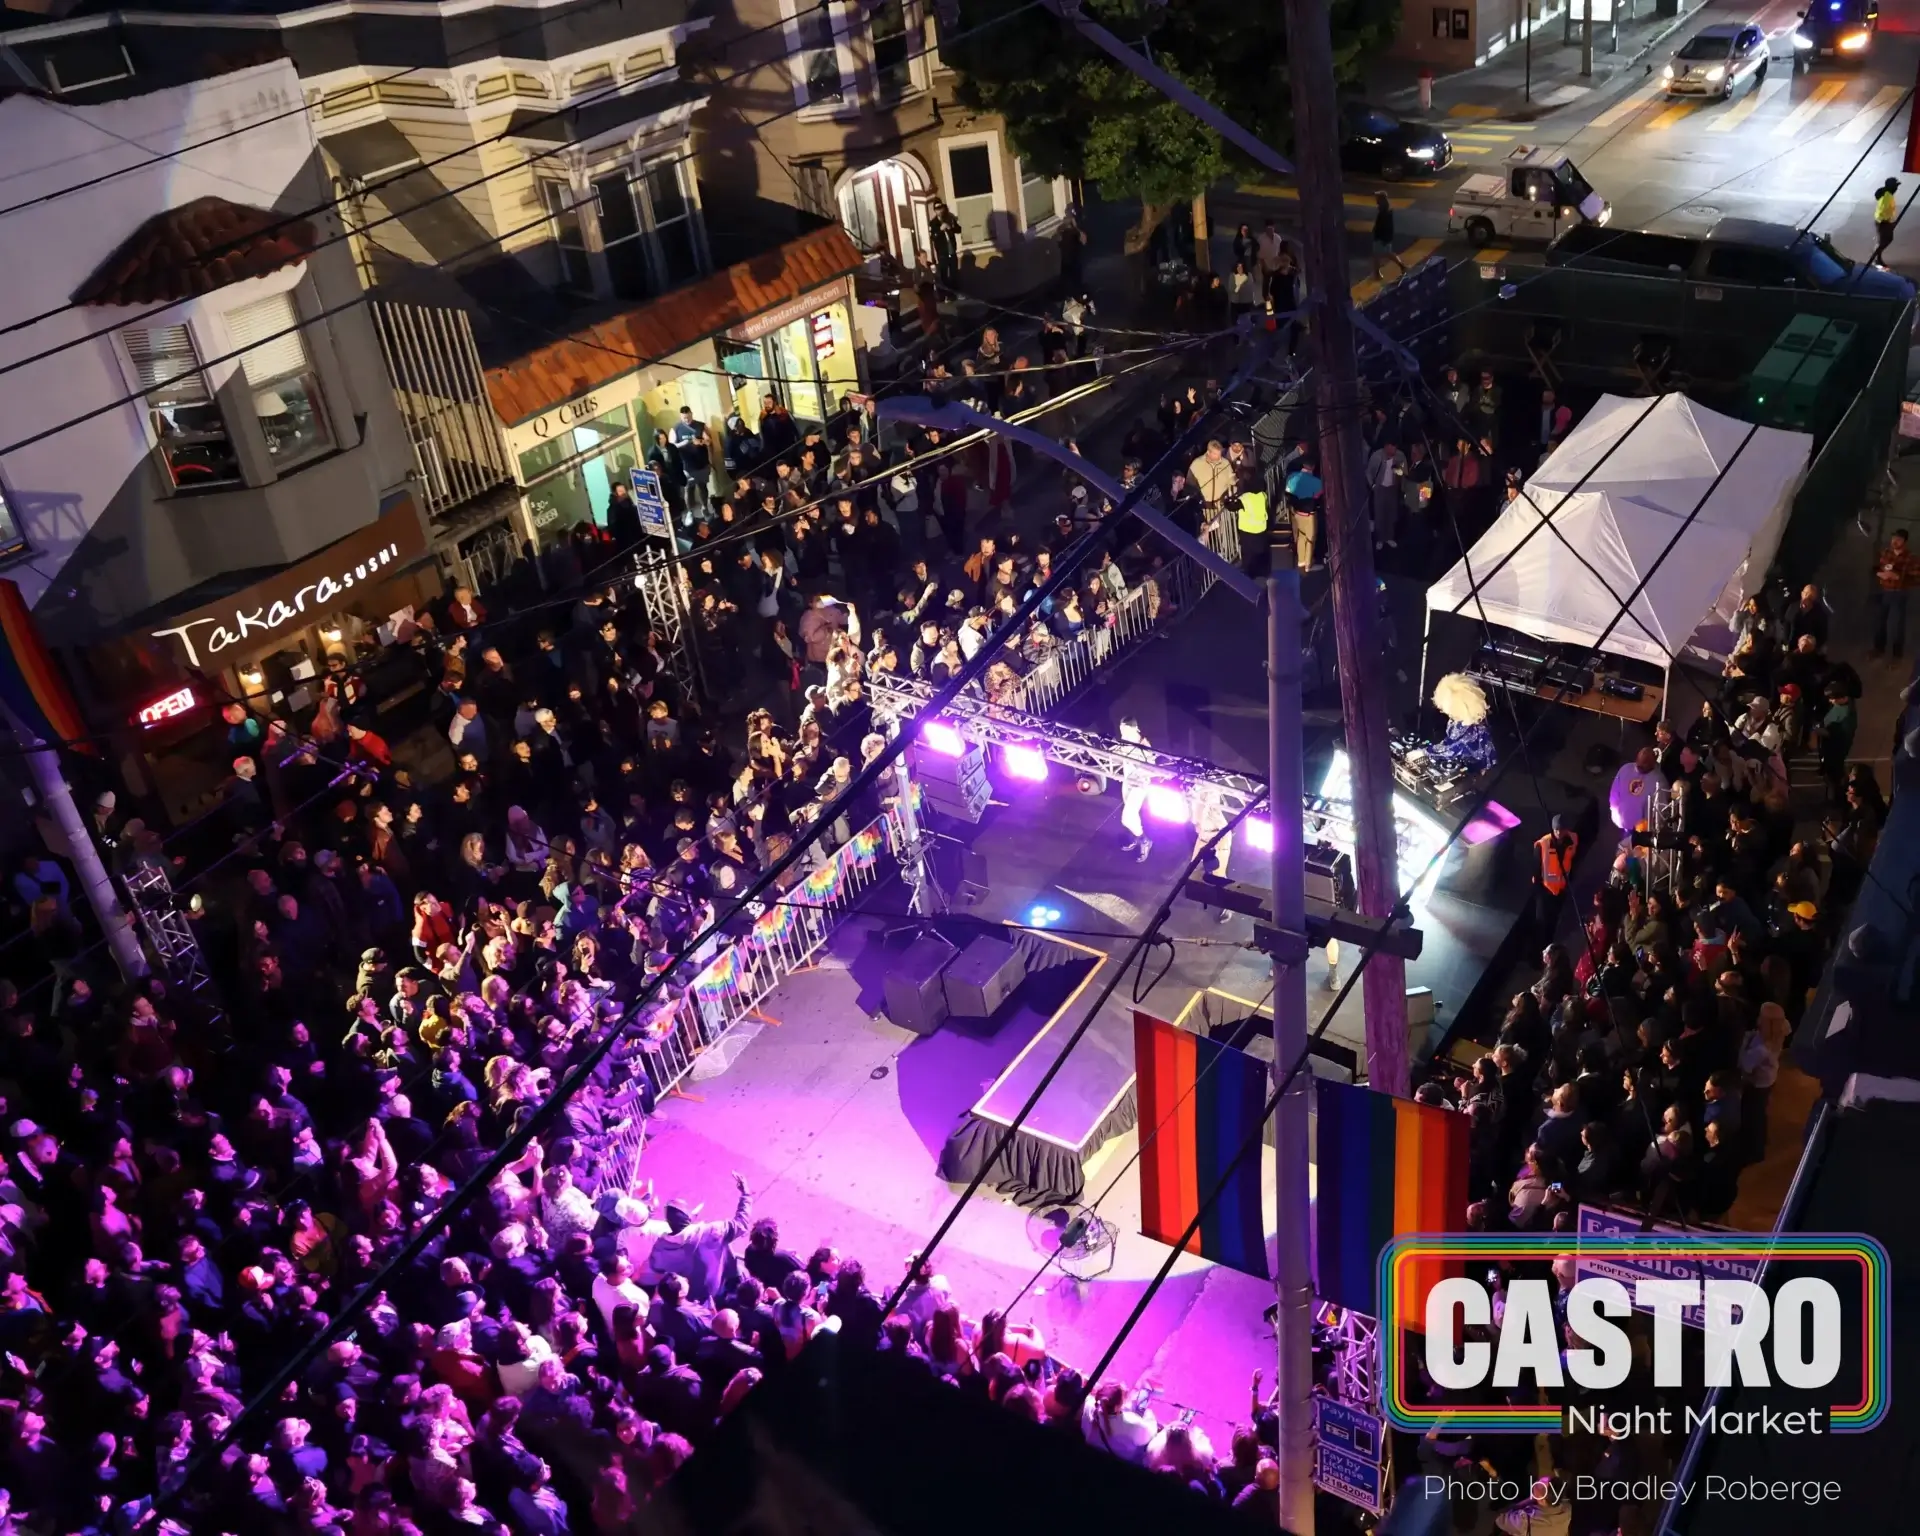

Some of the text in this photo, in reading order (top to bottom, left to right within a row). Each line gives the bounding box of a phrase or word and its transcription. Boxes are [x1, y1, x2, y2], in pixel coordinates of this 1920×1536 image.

[533, 396, 598, 438] Q Cuts
[343, 543, 399, 588] SUSHI
[139, 687, 195, 723] OPEN
[1322, 1402, 1377, 1430] Pay here
[1323, 1448, 1361, 1471] Pay by
[1323, 1456, 1365, 1481] License
[1323, 1465, 1352, 1483] Plate
